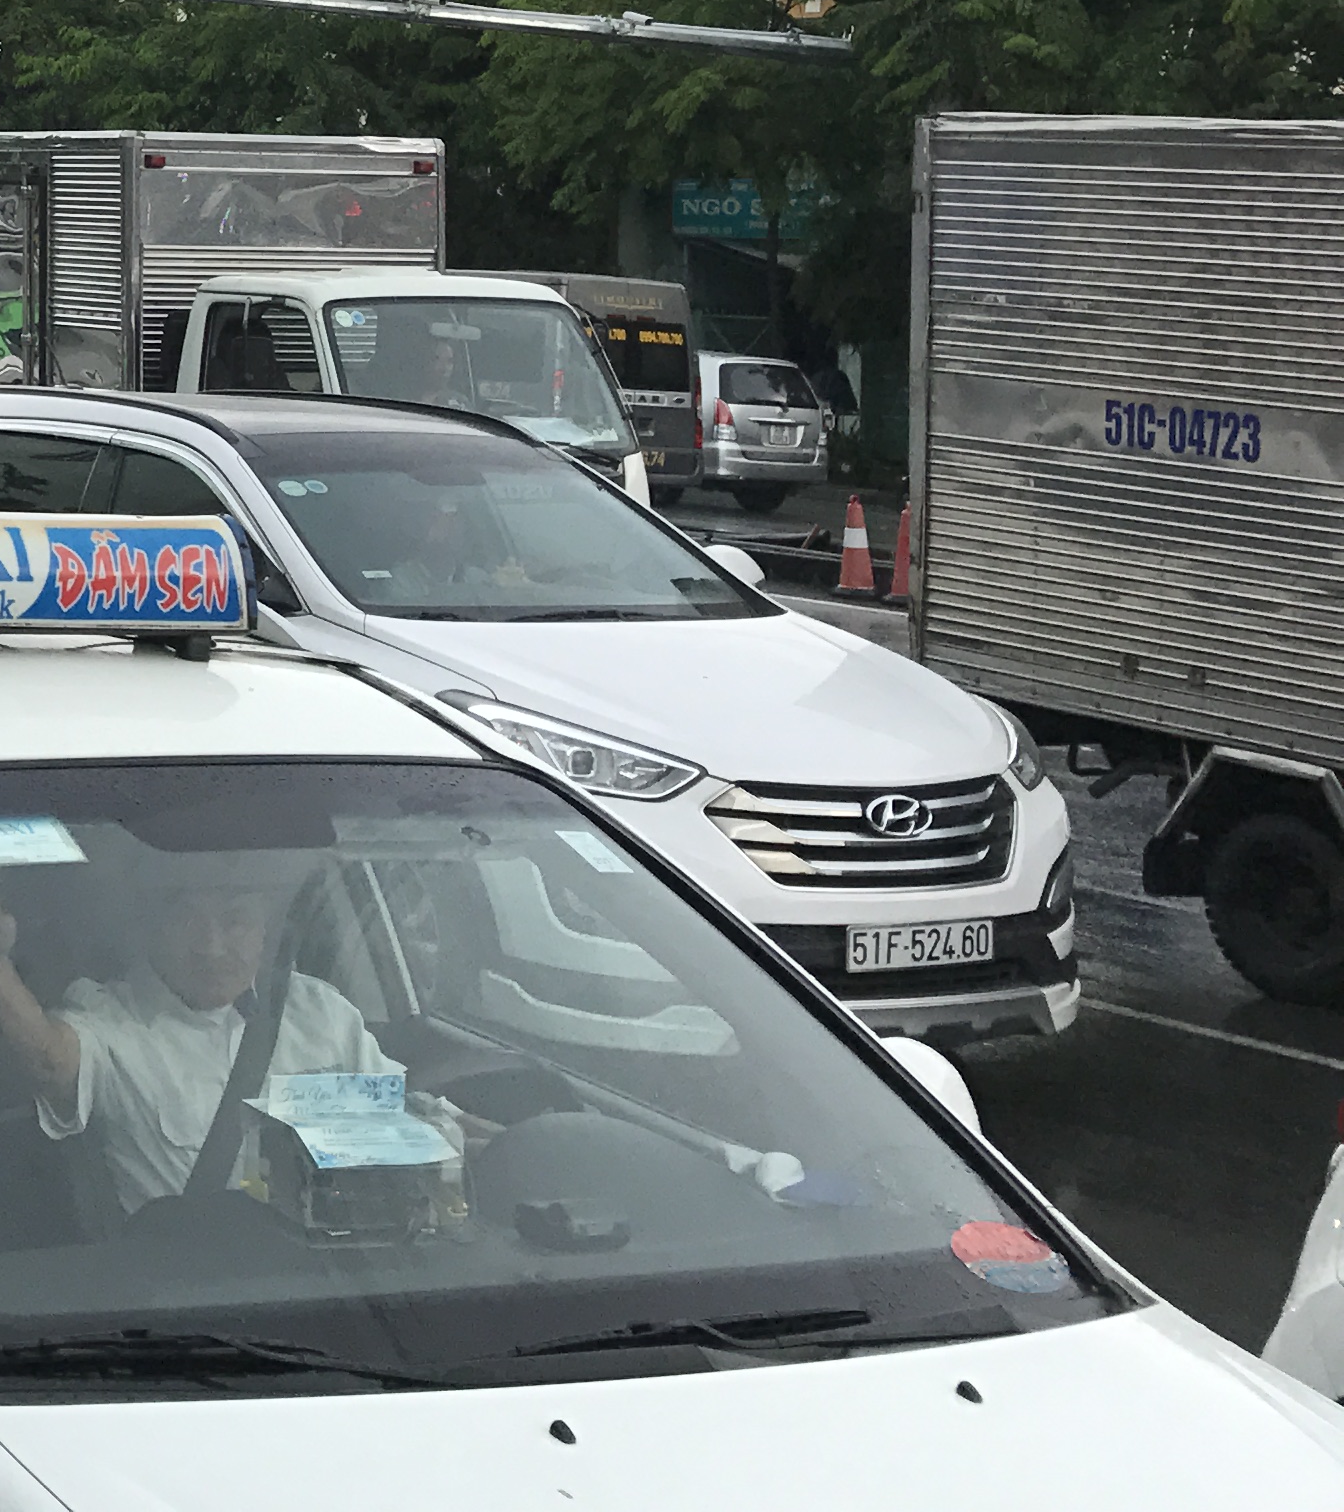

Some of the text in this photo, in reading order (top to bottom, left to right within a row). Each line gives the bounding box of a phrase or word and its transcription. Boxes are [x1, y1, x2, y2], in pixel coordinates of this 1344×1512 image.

[1104, 399, 1261, 464] 51C-04723
[155, 543, 229, 613] SEN
[852, 923, 990, 966] 51F-524.60
